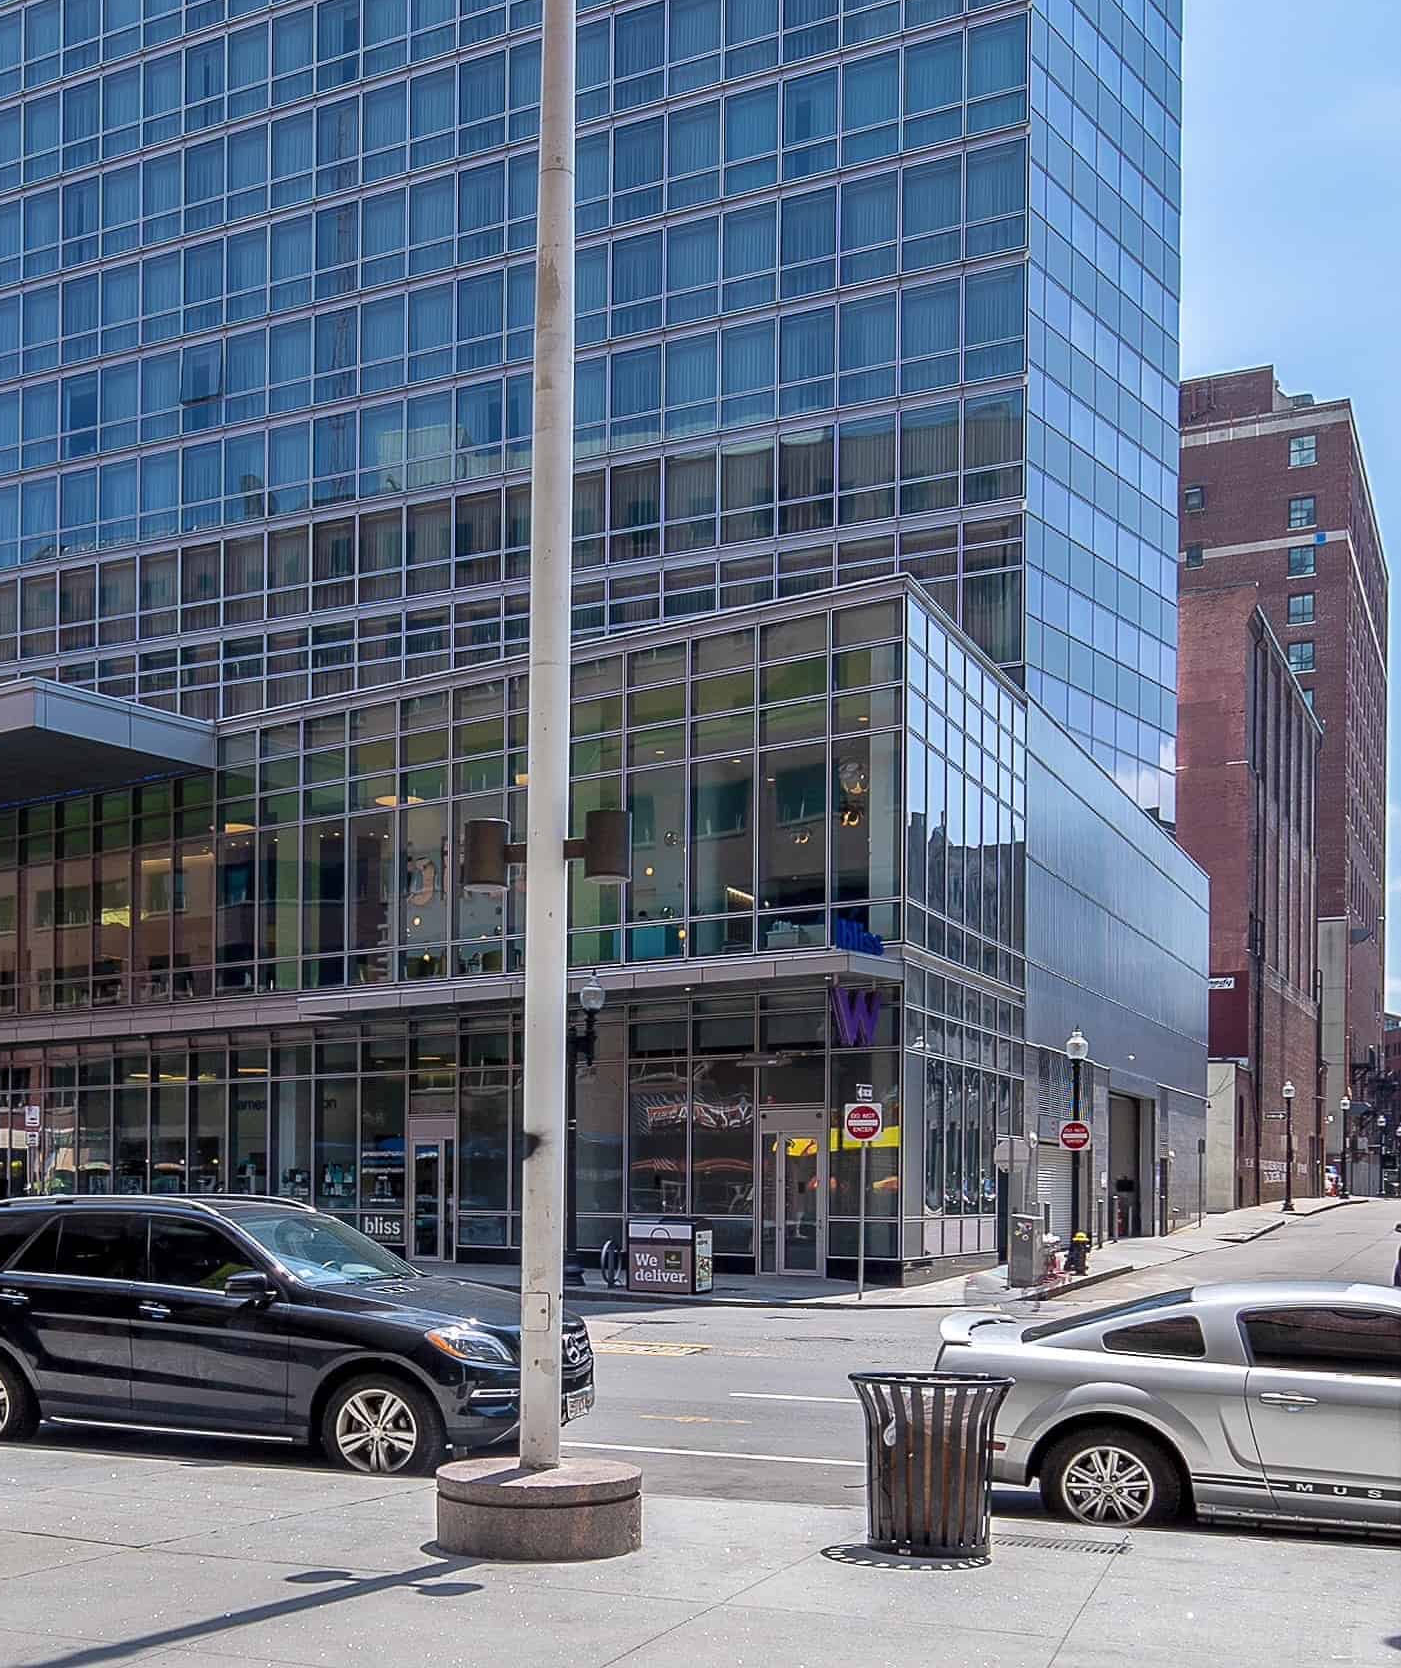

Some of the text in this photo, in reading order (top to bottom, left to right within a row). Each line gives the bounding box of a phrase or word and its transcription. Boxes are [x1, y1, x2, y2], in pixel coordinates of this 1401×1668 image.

[831, 987, 881, 1050] W
[364, 1216, 401, 1235] bliss
[634, 1252, 658, 1267] We
[634, 1268, 689, 1284] deliver.
[1295, 1483, 1383, 1500] MUS
